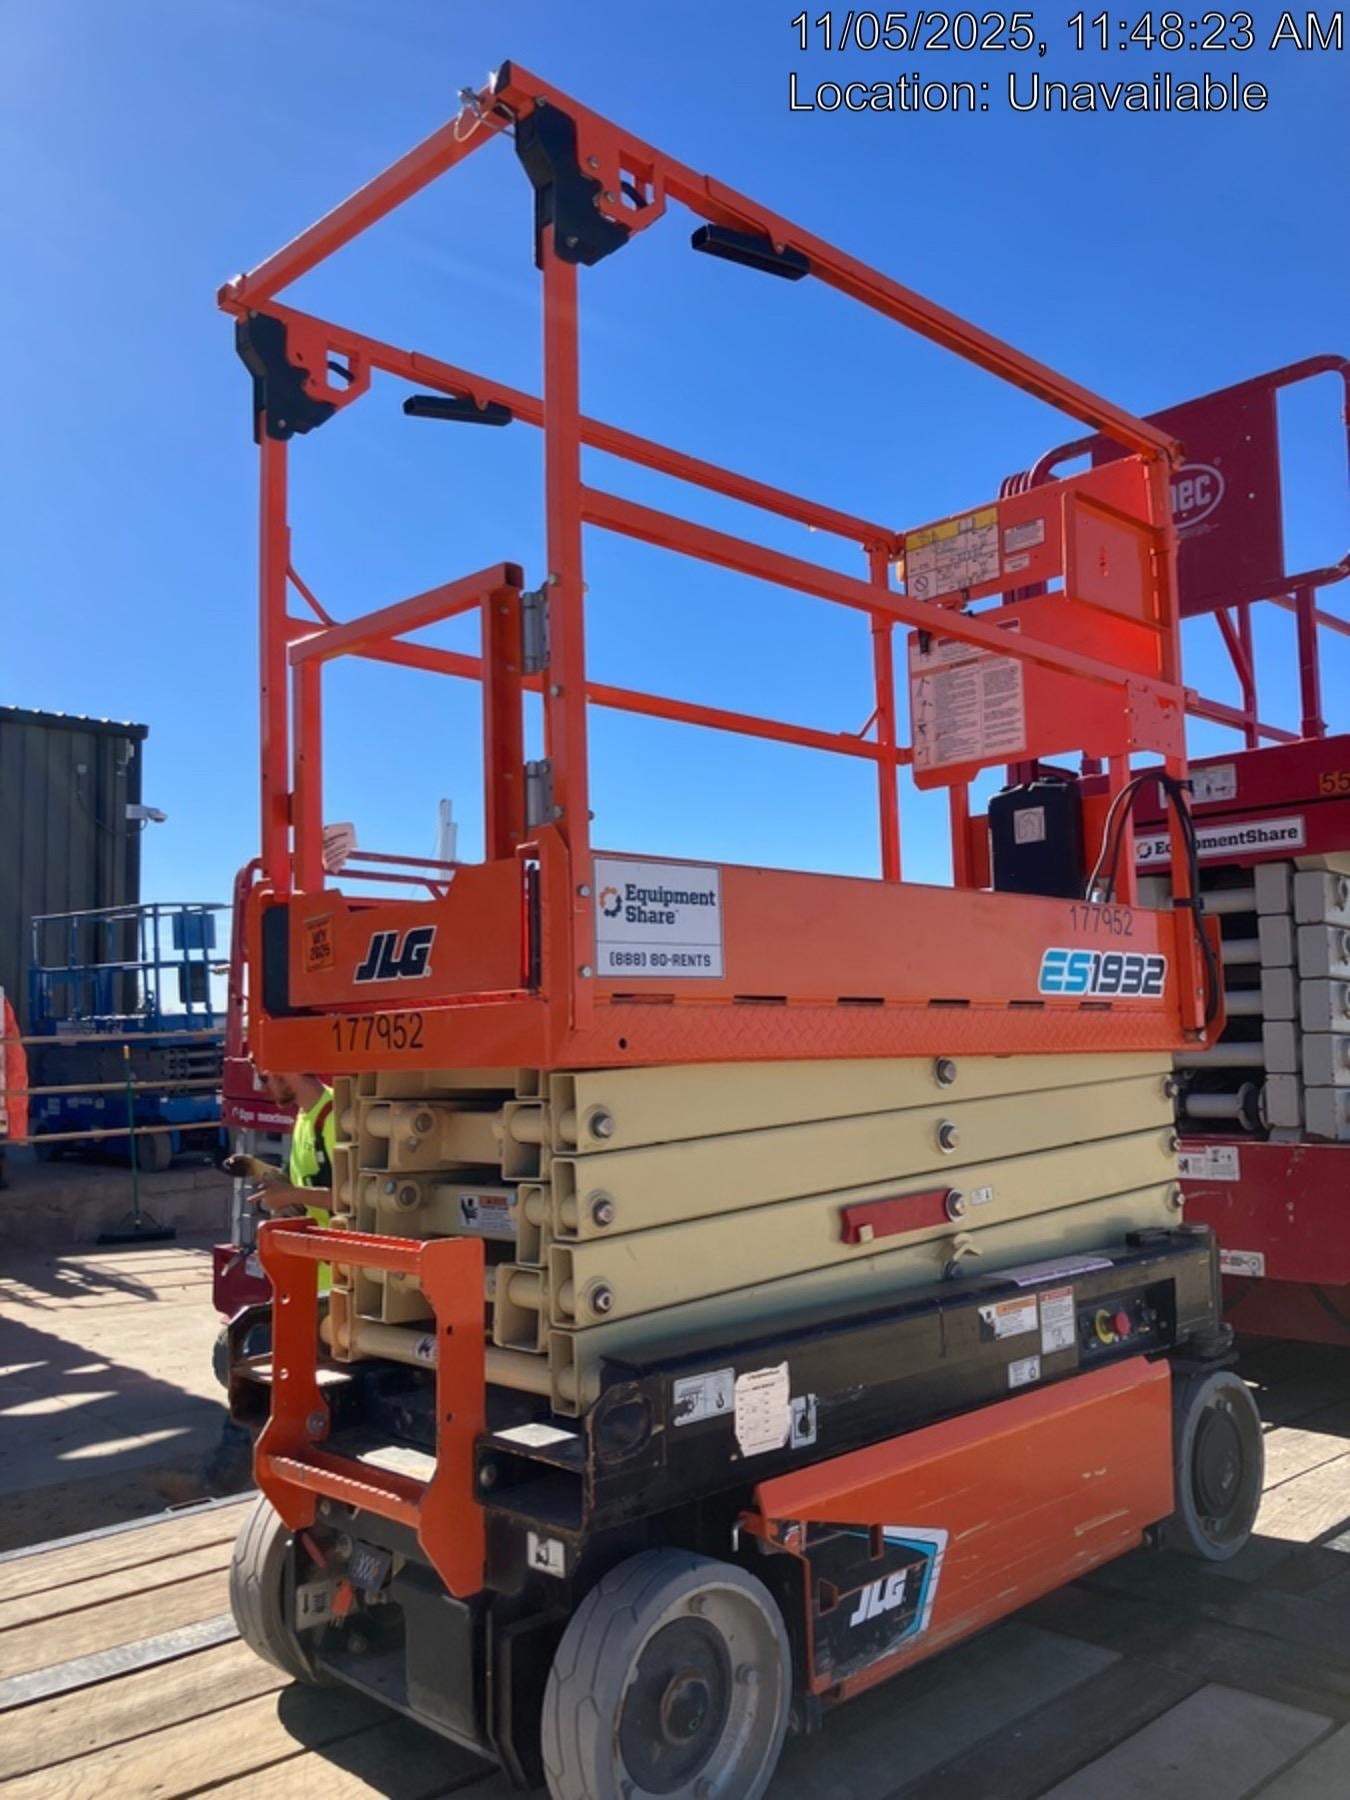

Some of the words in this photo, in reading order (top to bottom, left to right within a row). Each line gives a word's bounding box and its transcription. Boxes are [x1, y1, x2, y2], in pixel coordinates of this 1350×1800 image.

[625, 883, 716, 907] Equipment
[625, 905, 676, 925] Share
[1070, 905, 1134, 936] 177952
[352, 925, 437, 984] JLG
[609, 951, 647, 967] (888)
[649, 953, 711, 967] 80-RENTS
[1038, 947, 1168, 997] ES1932
[332, 1012, 424, 1053] 177952
[849, 1568, 907, 1628] JLG
